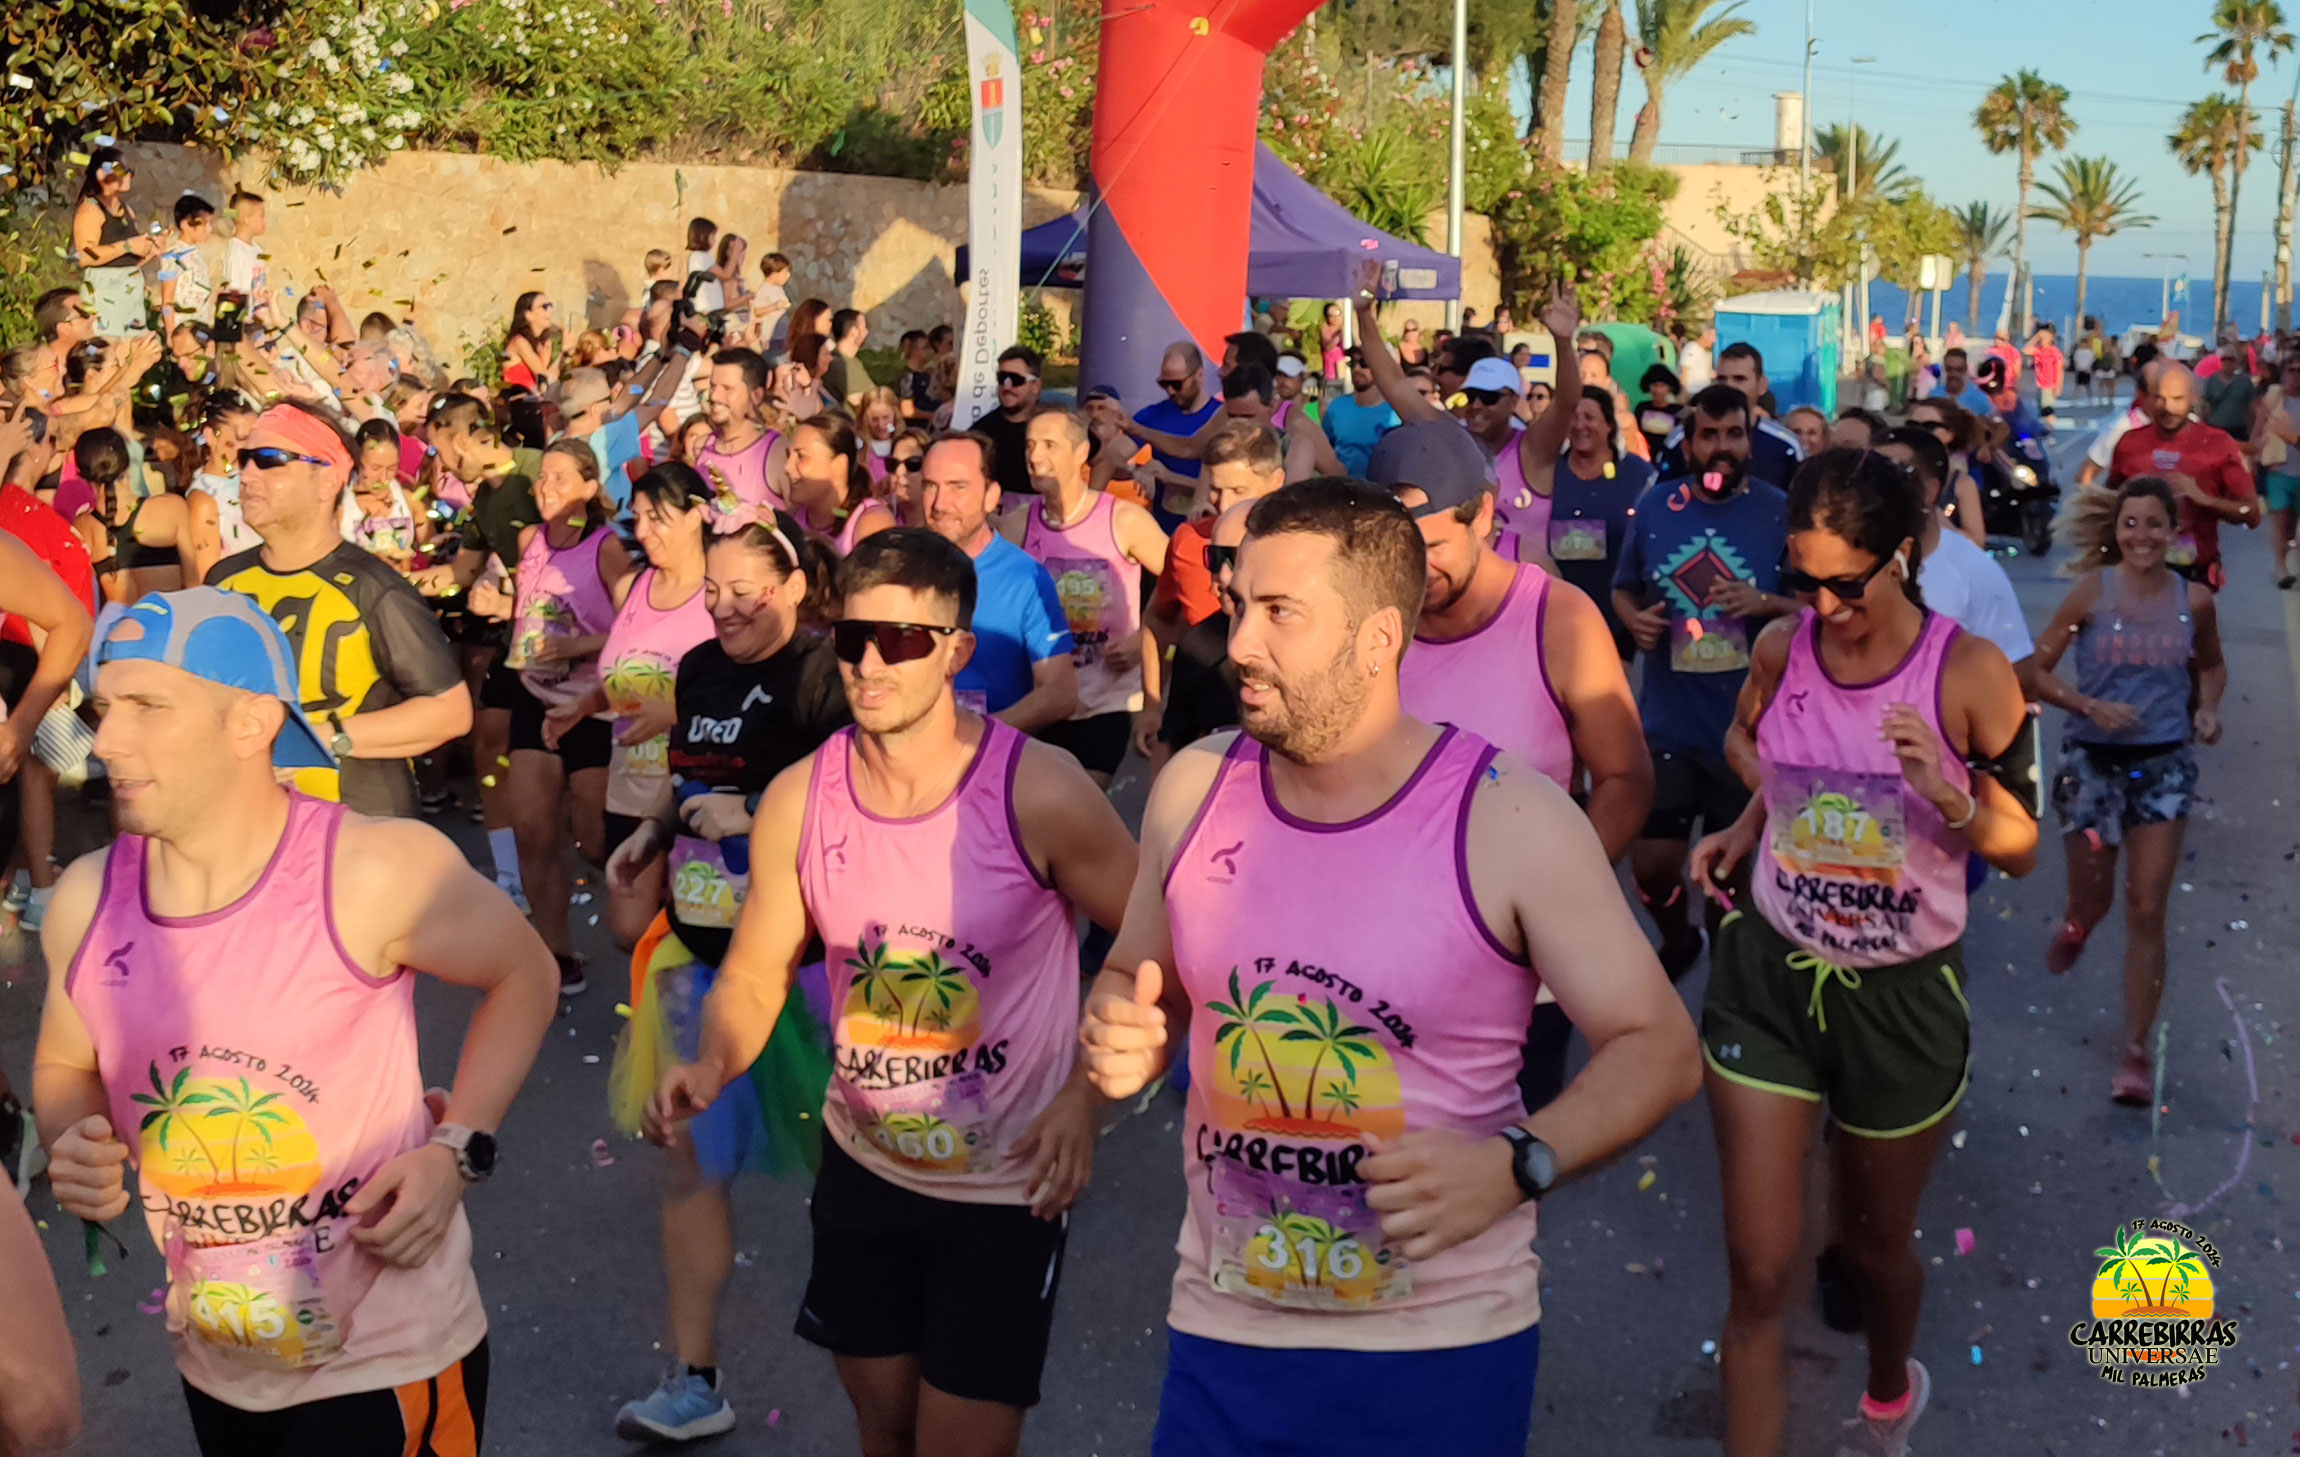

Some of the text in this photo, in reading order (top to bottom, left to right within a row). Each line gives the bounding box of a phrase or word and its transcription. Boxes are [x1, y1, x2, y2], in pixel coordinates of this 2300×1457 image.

[1799, 806, 1871, 843] 187
[674, 872, 728, 906] 227
[1254, 957, 1418, 1050] 17 AGOSTO 2024
[169, 1045, 188, 1062] 17
[200, 1045, 266, 1072] AGOSTO
[1257, 1223, 1363, 1280] 316
